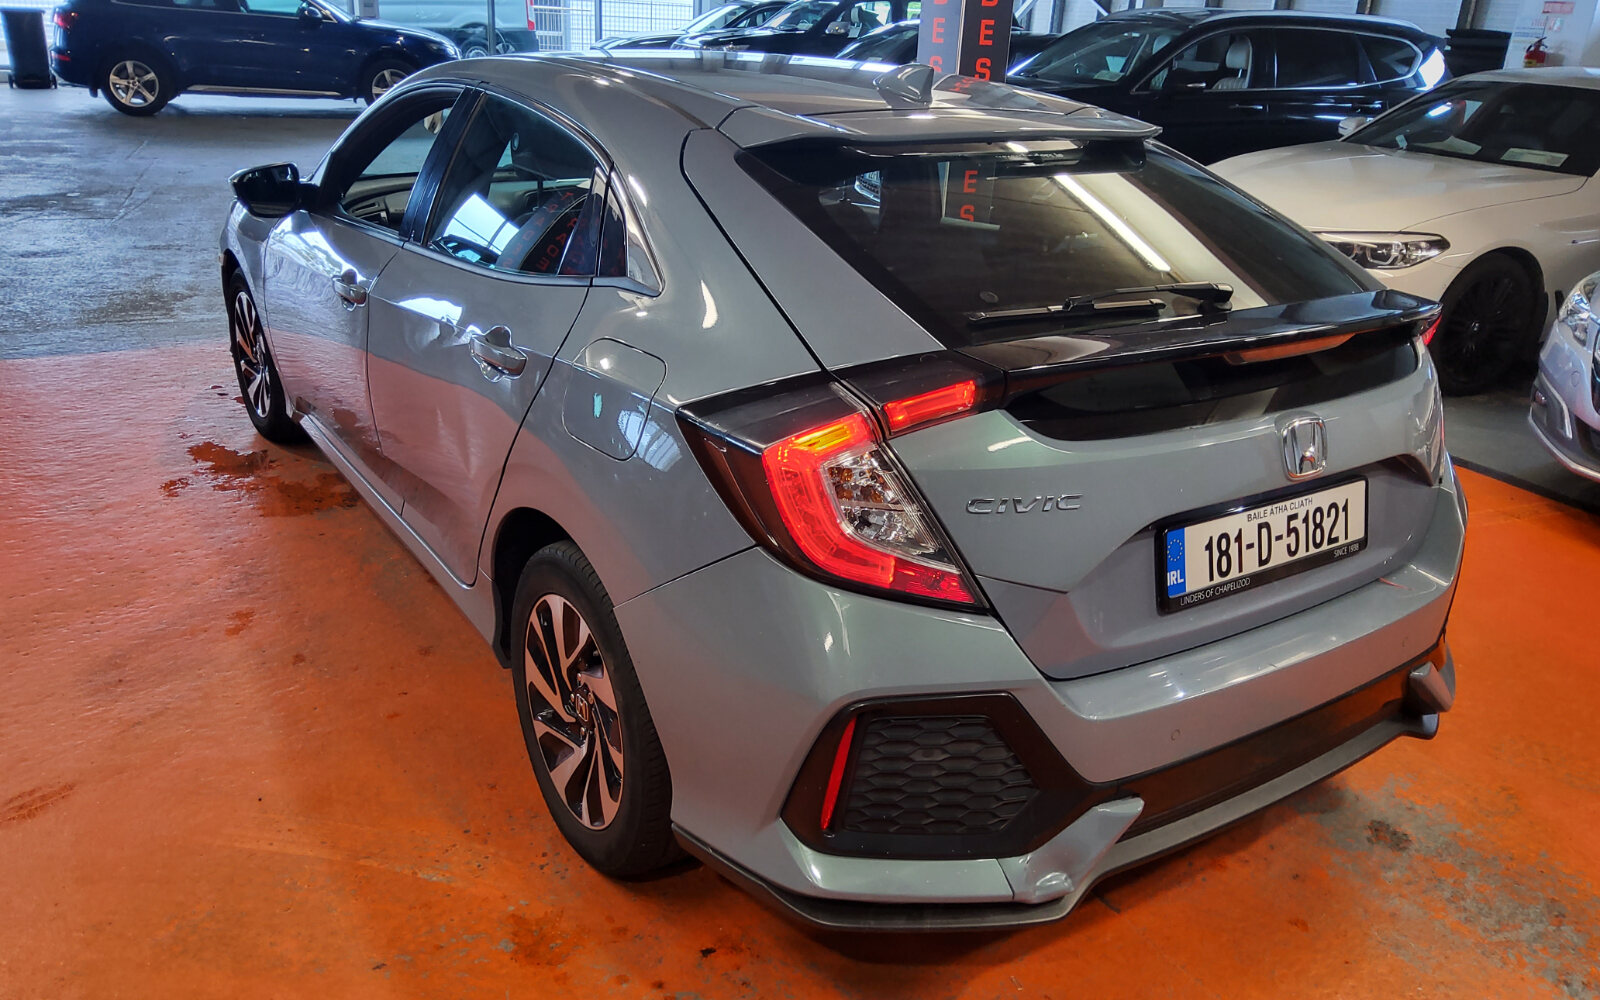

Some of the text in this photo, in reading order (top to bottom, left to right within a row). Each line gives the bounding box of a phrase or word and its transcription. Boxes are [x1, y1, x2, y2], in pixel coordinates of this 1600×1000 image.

[966, 494, 1083, 514] CIVIC
[1247, 497, 1313, 522] BAILE ÁTHA CLIATH
[1204, 498, 1349, 582] 181-D-51821
[1333, 546, 1348, 558] SINCE
[1166, 569, 1184, 587] IRL
[1180, 577, 1251, 606] LINDERS OF CHAPELIZOD
